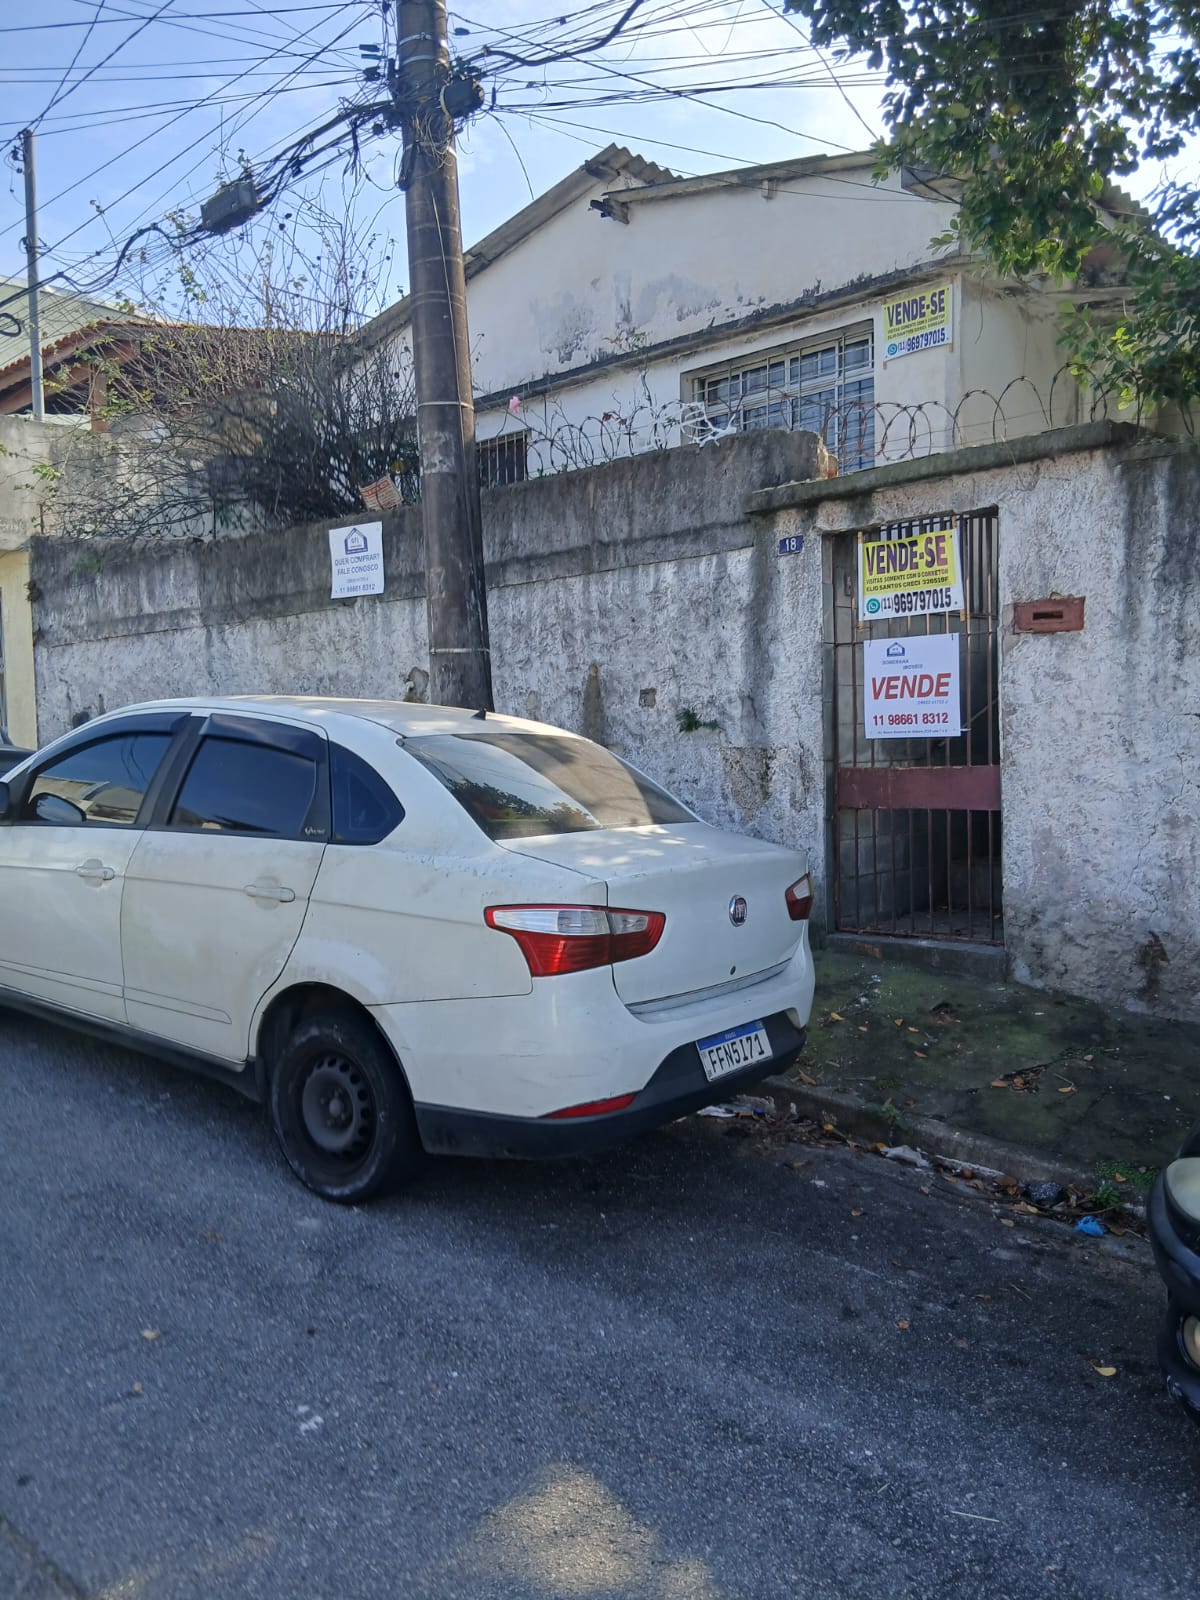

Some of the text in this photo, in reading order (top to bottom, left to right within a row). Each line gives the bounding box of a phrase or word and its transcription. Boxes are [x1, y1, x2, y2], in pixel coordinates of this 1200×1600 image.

[887, 290, 946, 328] VENDE-SE
[785, 537, 797, 552] 18
[335, 557, 349, 566] QUER
[866, 535, 948, 576] VENDE-SE
[338, 563, 379, 576] FALE CONOSCO
[866, 577, 883, 585] VISITAS
[884, 574, 906, 583] SOMENTE
[879, 581, 902, 590] SANTOS
[903, 579, 921, 588] CRECI
[871, 672, 952, 701] VENDE
[873, 712, 949, 726] 11 98661 8312
